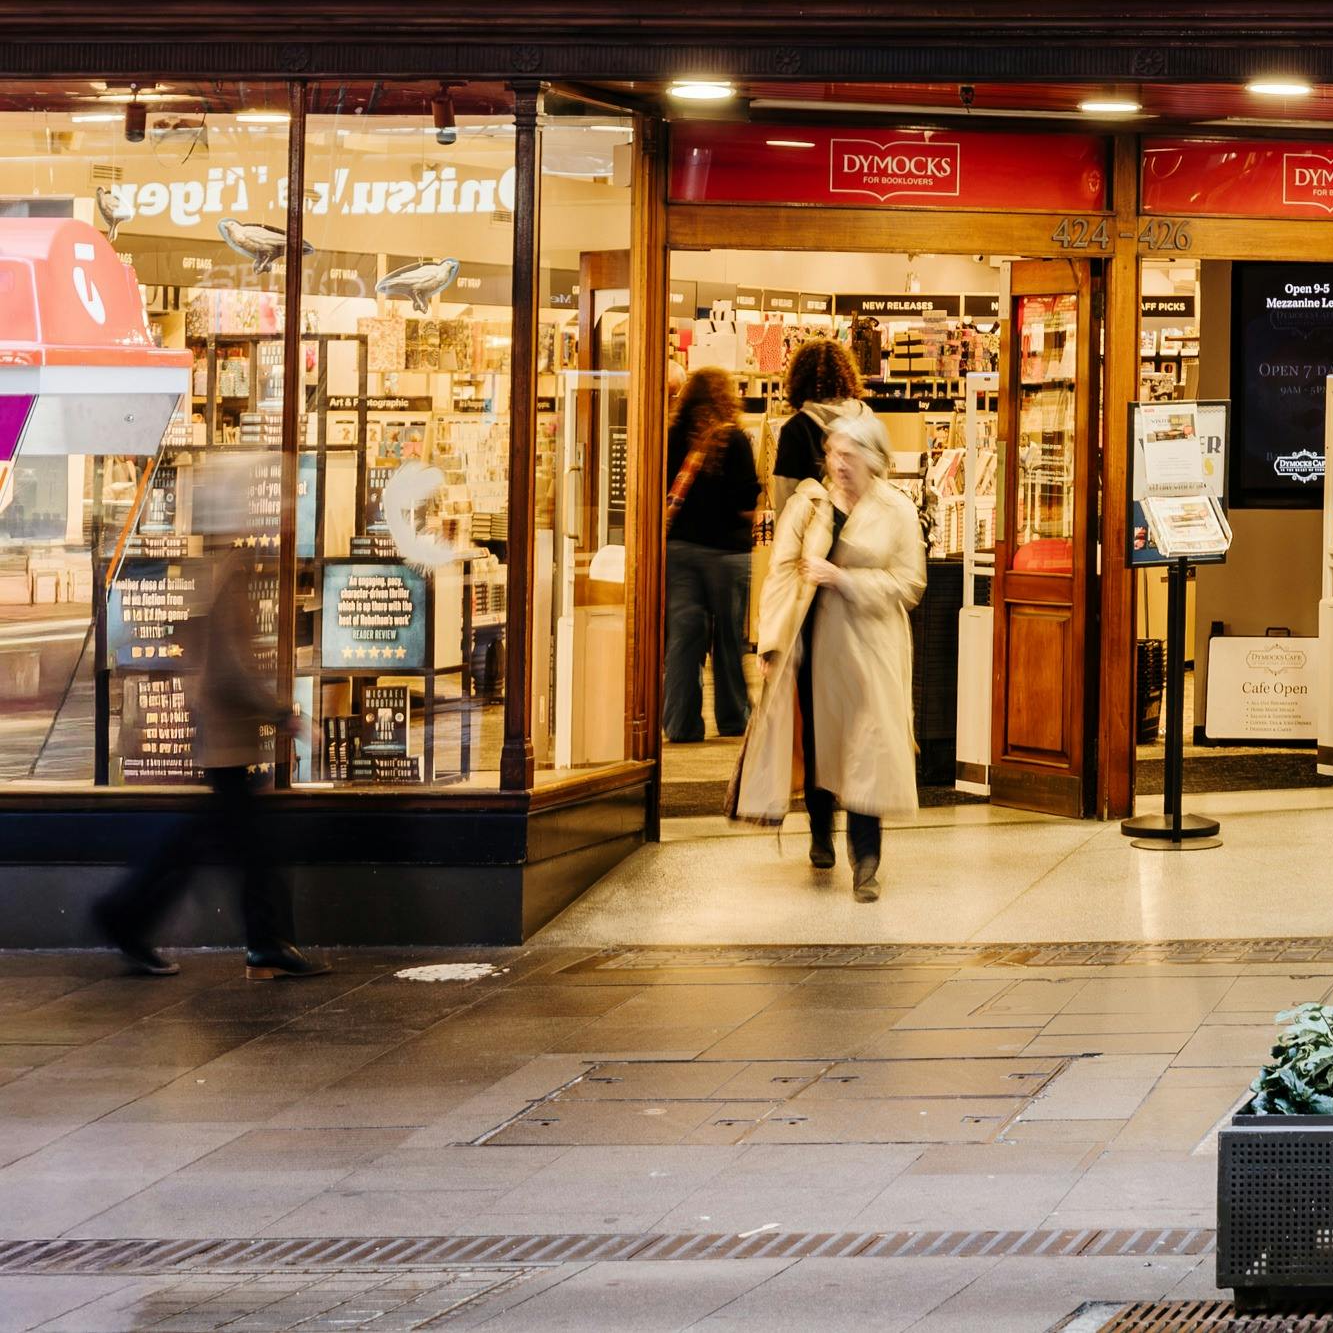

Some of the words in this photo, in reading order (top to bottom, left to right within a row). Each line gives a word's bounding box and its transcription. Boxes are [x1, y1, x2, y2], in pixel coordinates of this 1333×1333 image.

[843, 154, 951, 178] DYMOCKS
[863, 176, 880, 184] FOR
[881, 177, 933, 185] BOOKLOVERS
[182, 257, 195, 268] GIFT
[196, 259, 212, 270] BAGS
[330, 269, 342, 278] GIFT
[457, 277, 468, 286] GIFT
[1284, 284, 1312, 296] Open
[1314, 283, 1330, 294] 9-5
[862, 301, 884, 311] NEW
[887, 301, 933, 311] RELEASES
[1158, 302, 1185, 311] PICKS
[1266, 298, 1320, 308] Mezzanine
[1259, 363, 1299, 377] OPEN
[1303, 365, 1312, 379] 7
[329, 397, 343, 408] Art
[344, 398, 352, 407] &
[1279, 459, 1312, 468] DYMOCKS
[140, 579, 156, 590] dose
[157, 579, 165, 590] of
[166, 578, 195, 591] brilliant
[338, 601, 354, 613] which
[401, 601, 412, 613] the
[352, 630, 375, 640] READER
[376, 630, 397, 640] REVIEW
[365, 689, 404, 698] MICHAEL
[1242, 681, 1270, 695] Cafe
[1274, 681, 1308, 697] Open
[365, 698, 404, 708] ROBOTHAM
